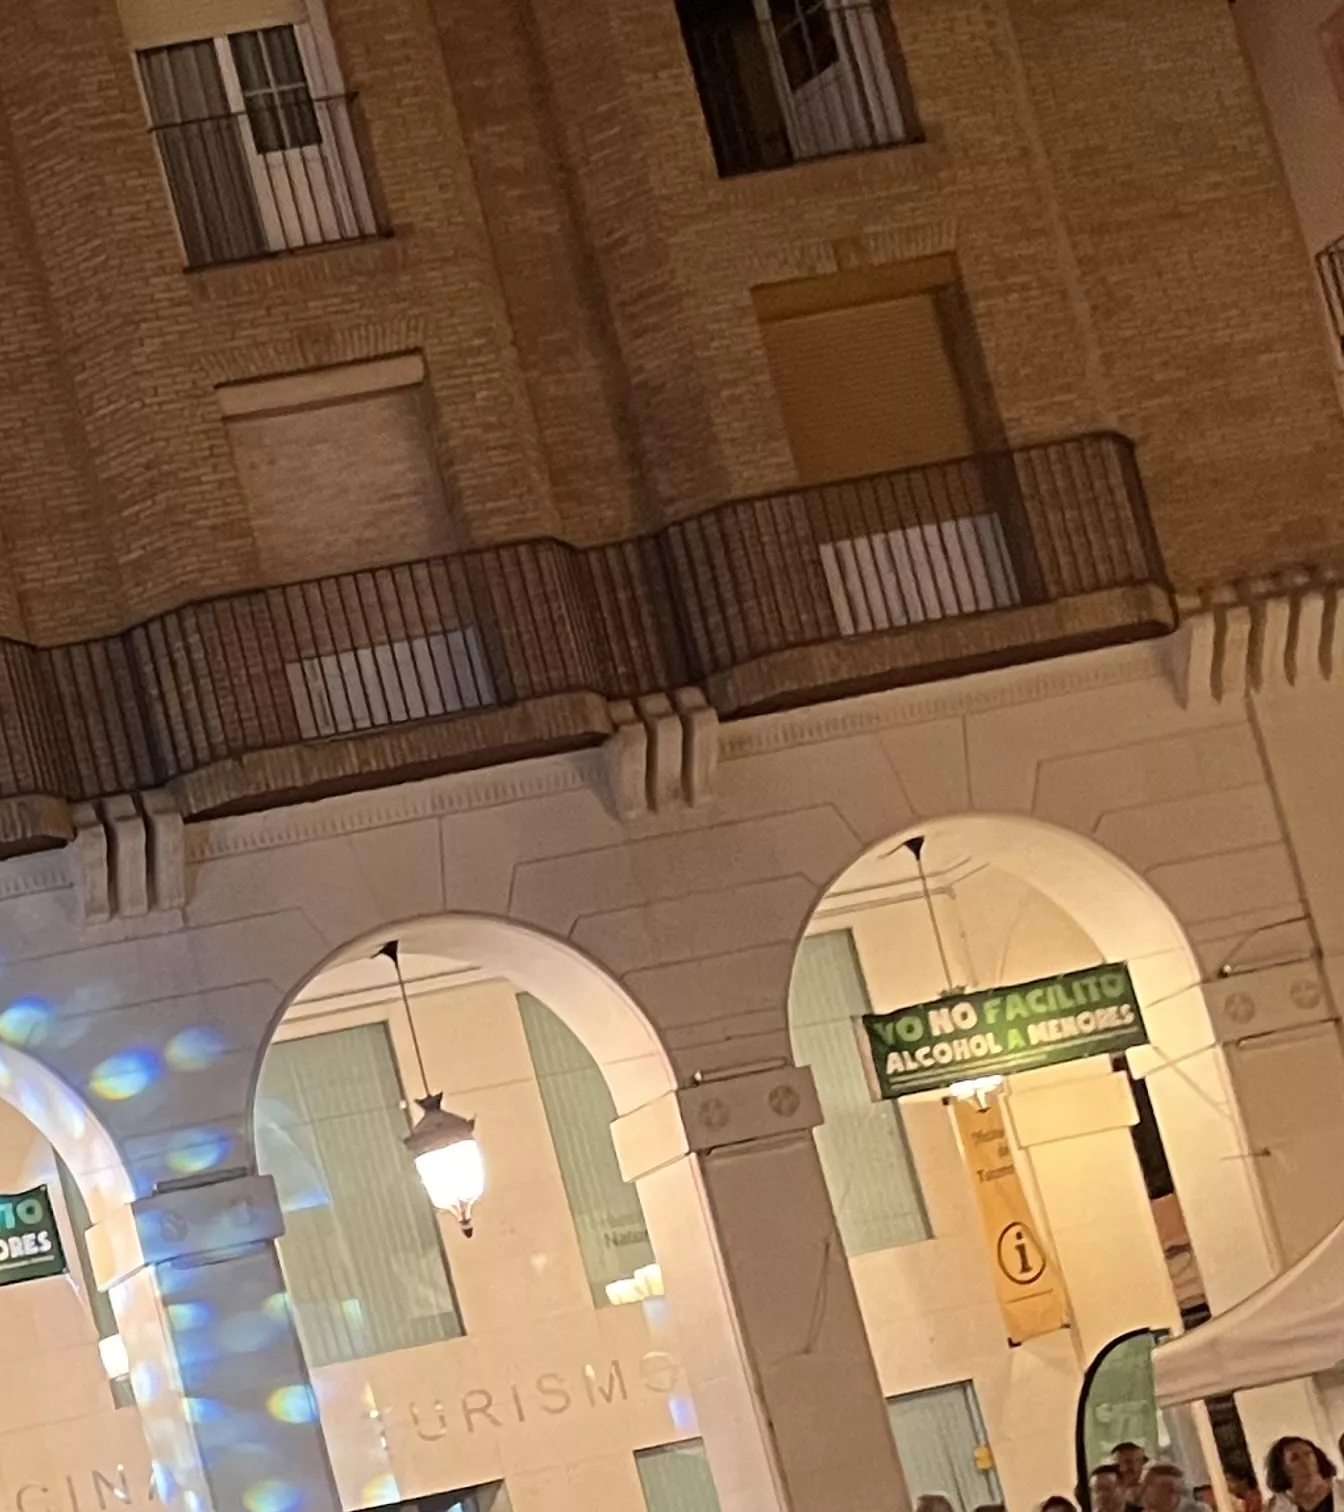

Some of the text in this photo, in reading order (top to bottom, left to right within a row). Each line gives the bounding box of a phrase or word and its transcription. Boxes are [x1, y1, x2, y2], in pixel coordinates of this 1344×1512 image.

[885, 1032, 1002, 1075] ALCOHOL
[1007, 1028, 1026, 1050] A
[1026, 1003, 1135, 1045] MENORES
[928, 1001, 978, 1037] NO
[983, 972, 1126, 1024] FACILITO
[409, 1350, 681, 1442] URISMO
